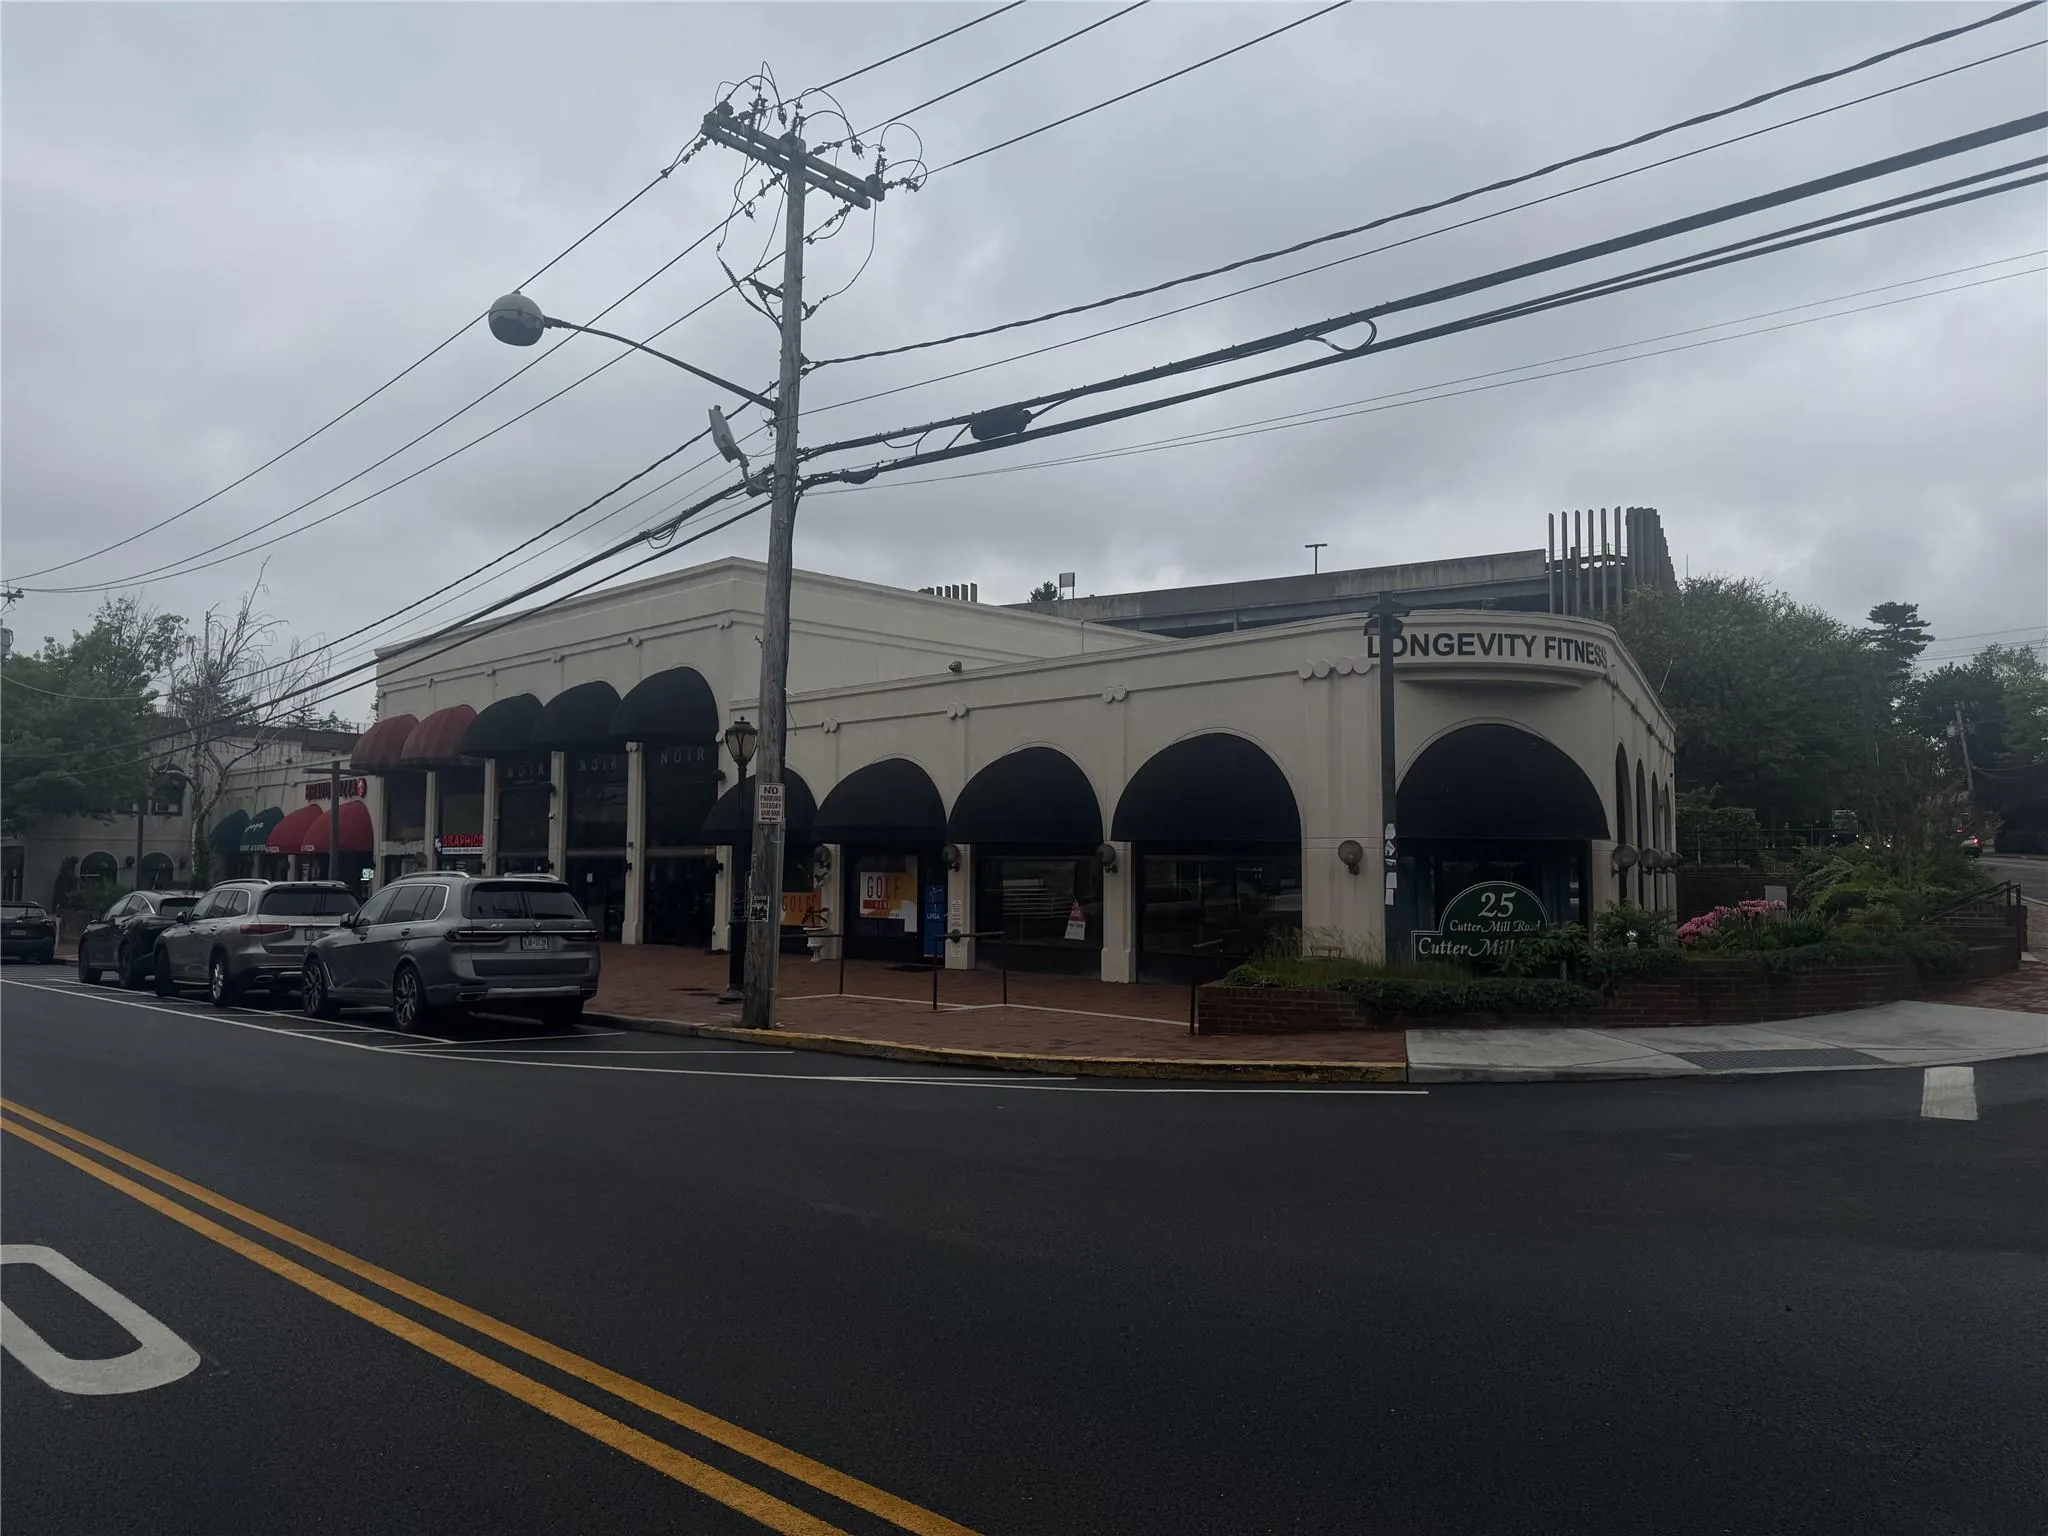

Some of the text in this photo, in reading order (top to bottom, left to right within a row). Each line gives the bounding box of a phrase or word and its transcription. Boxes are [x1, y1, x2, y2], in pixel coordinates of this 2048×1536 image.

[1367, 633, 1608, 669] LONGEVITY FITNESS
[660, 747, 705, 766] NOIR
[763, 786, 779, 795] NO
[867, 875, 900, 899] GOLF
[1477, 891, 1517, 918] 25
[1449, 919, 1482, 932] Cutter
[1481, 920, 1511, 933] Mill
[1418, 937, 1470, 955] Cutter
[1469, 938, 1516, 957] Mill
